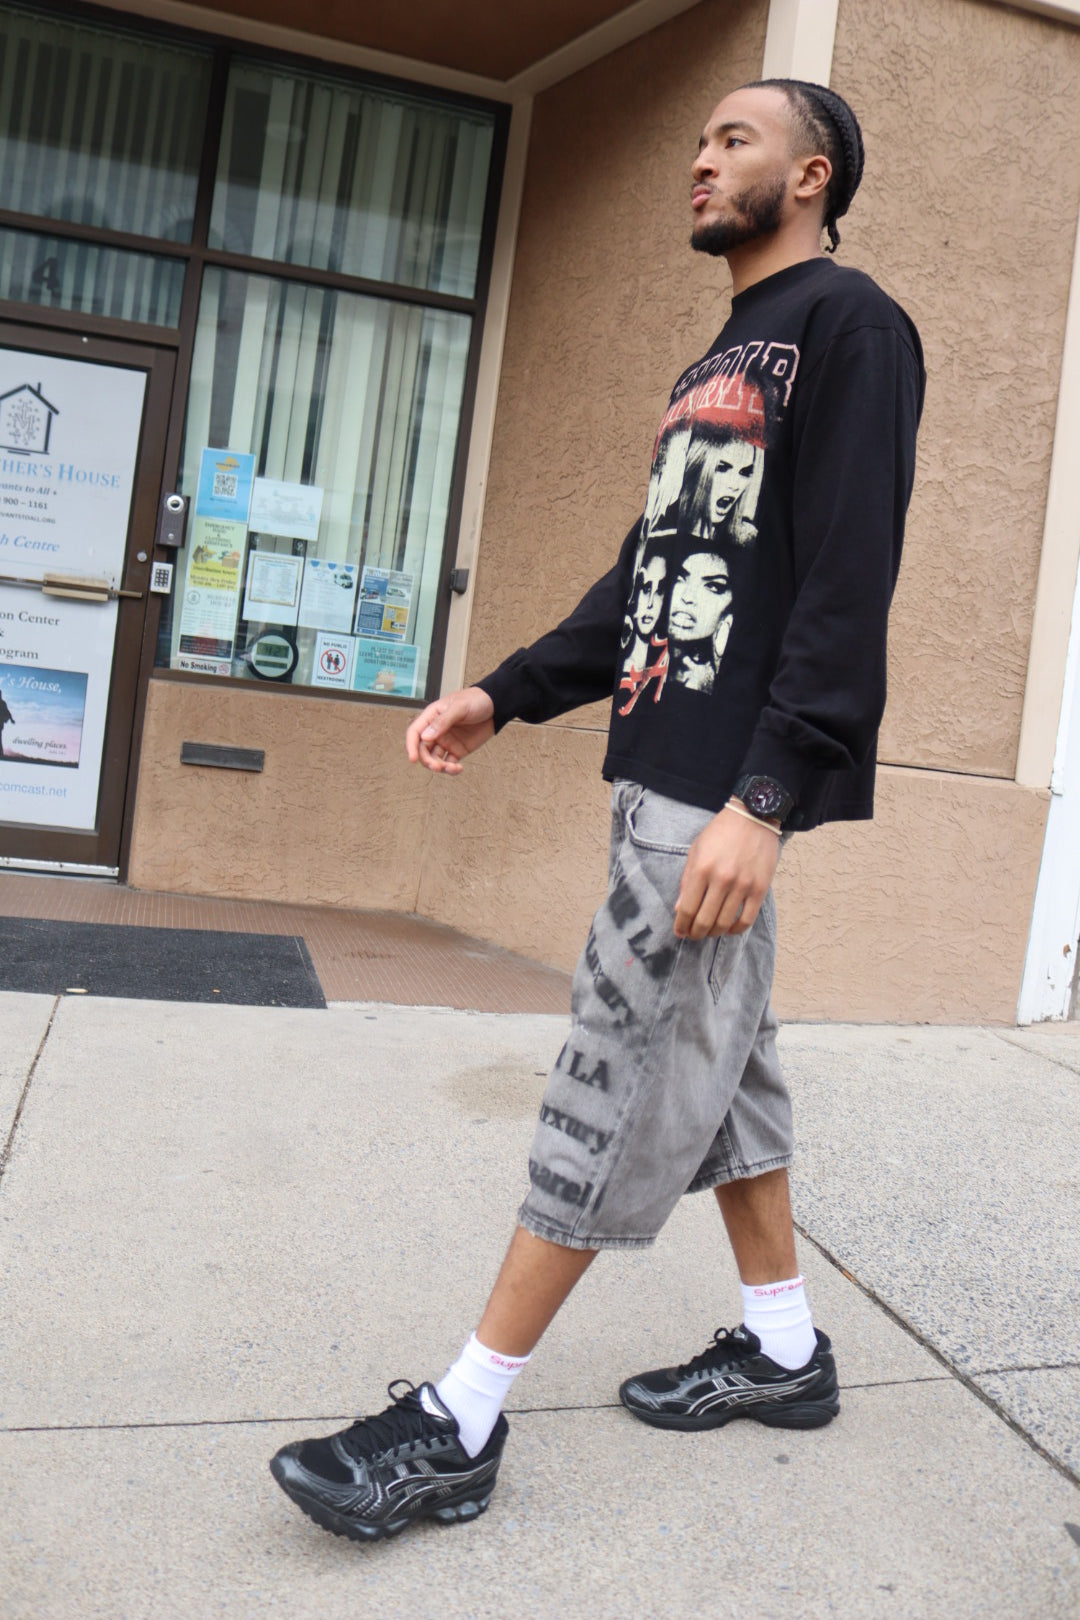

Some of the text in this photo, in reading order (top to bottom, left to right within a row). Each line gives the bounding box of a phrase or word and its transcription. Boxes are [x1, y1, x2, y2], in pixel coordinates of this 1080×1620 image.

[0, 458, 52, 479] HER'S
[36, 486, 50, 495] All
[28, 500, 48, 510] 1161
[13, 535, 62, 552] Centre
[18, 611, 61, 626] Center
[180, 660, 218, 674] No Smoking
[12, 736, 44, 749] dwelling
